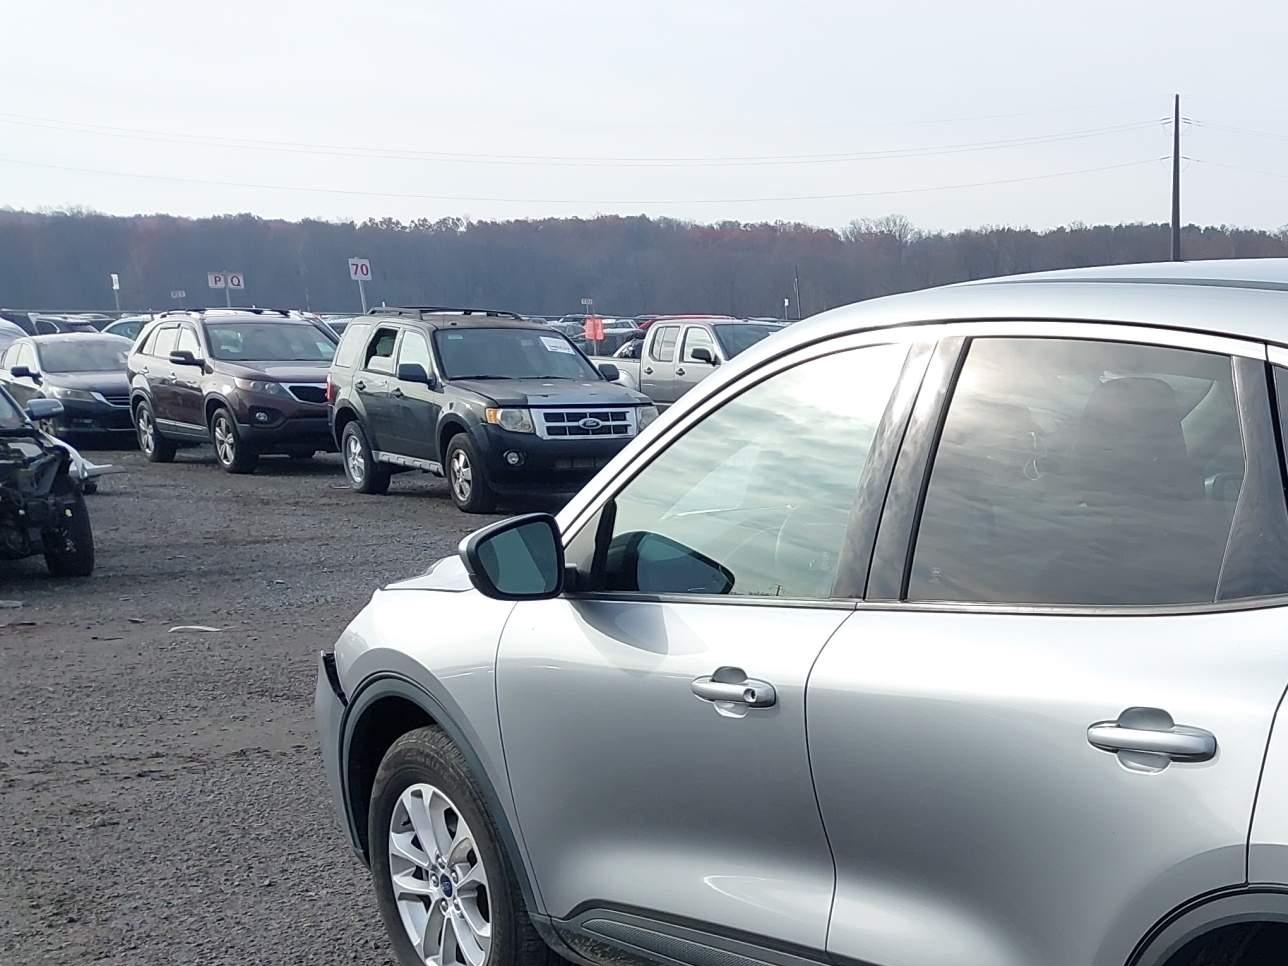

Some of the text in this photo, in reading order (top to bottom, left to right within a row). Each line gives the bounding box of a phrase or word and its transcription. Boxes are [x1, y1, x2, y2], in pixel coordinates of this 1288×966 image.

[351, 263, 369, 277] 70
[213, 275, 222, 286] P
[230, 275, 241, 287] Q
